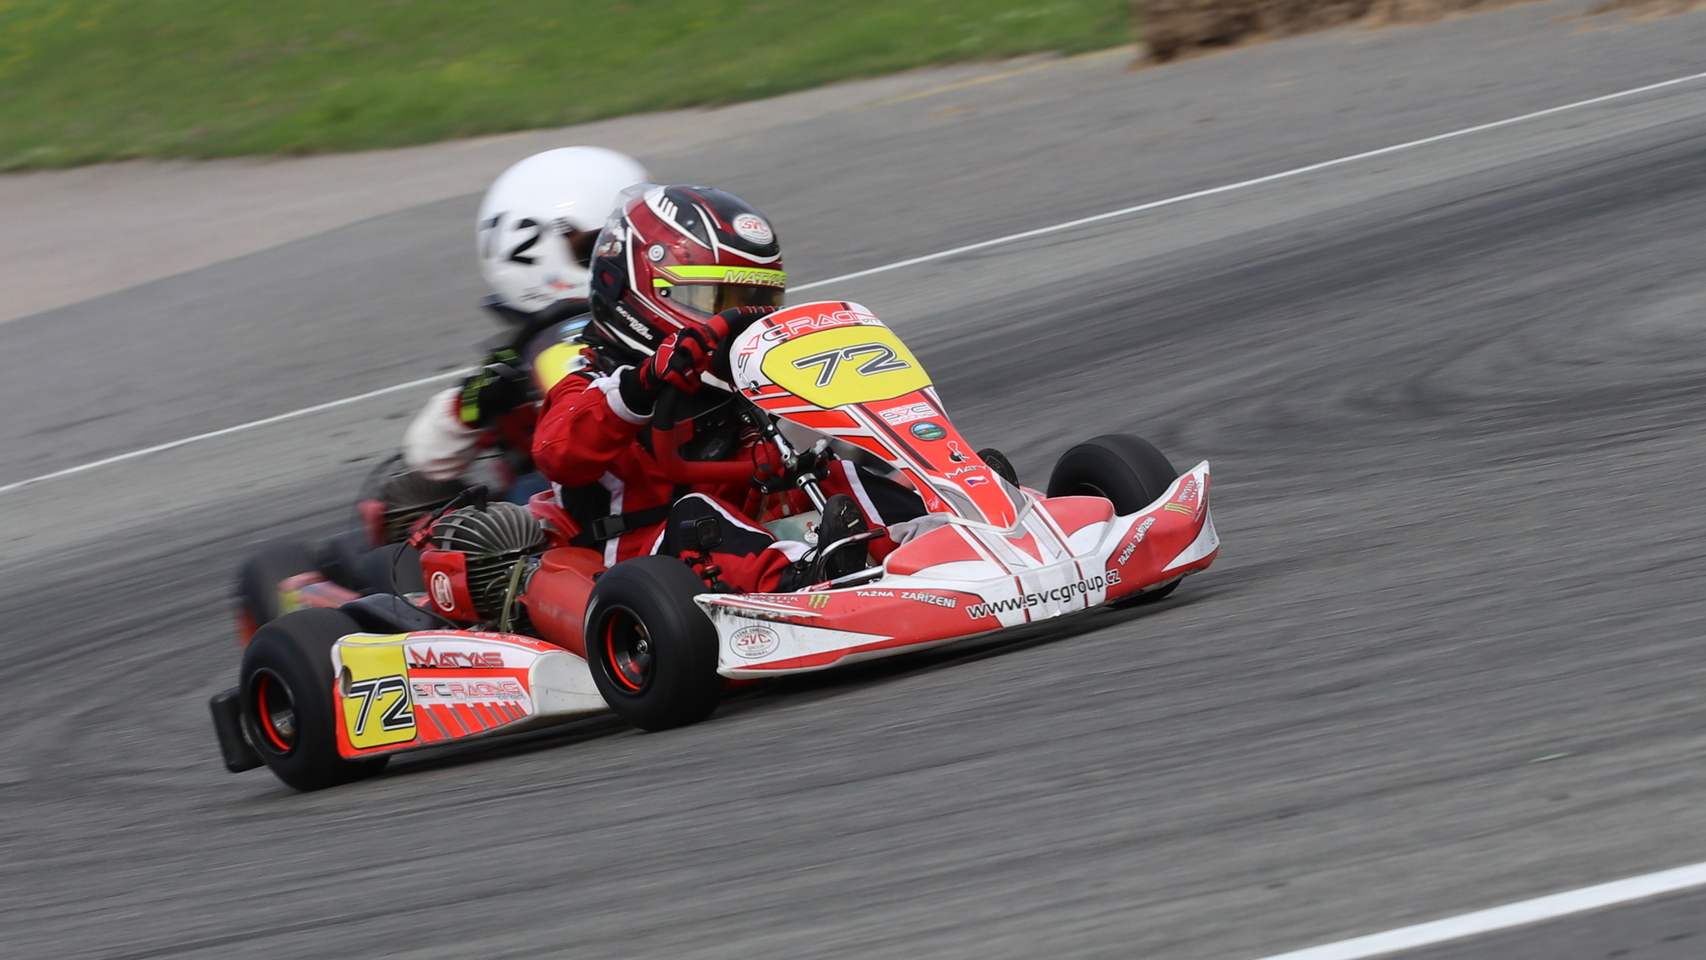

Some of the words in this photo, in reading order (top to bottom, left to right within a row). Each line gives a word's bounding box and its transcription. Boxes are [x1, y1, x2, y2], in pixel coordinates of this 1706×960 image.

[792, 342, 911, 388] 72
[966, 570, 1121, 620] www.svcgroup.cz
[409, 646, 505, 669] MATYAS
[737, 634, 772, 646] SVC
[349, 674, 416, 736] 72
